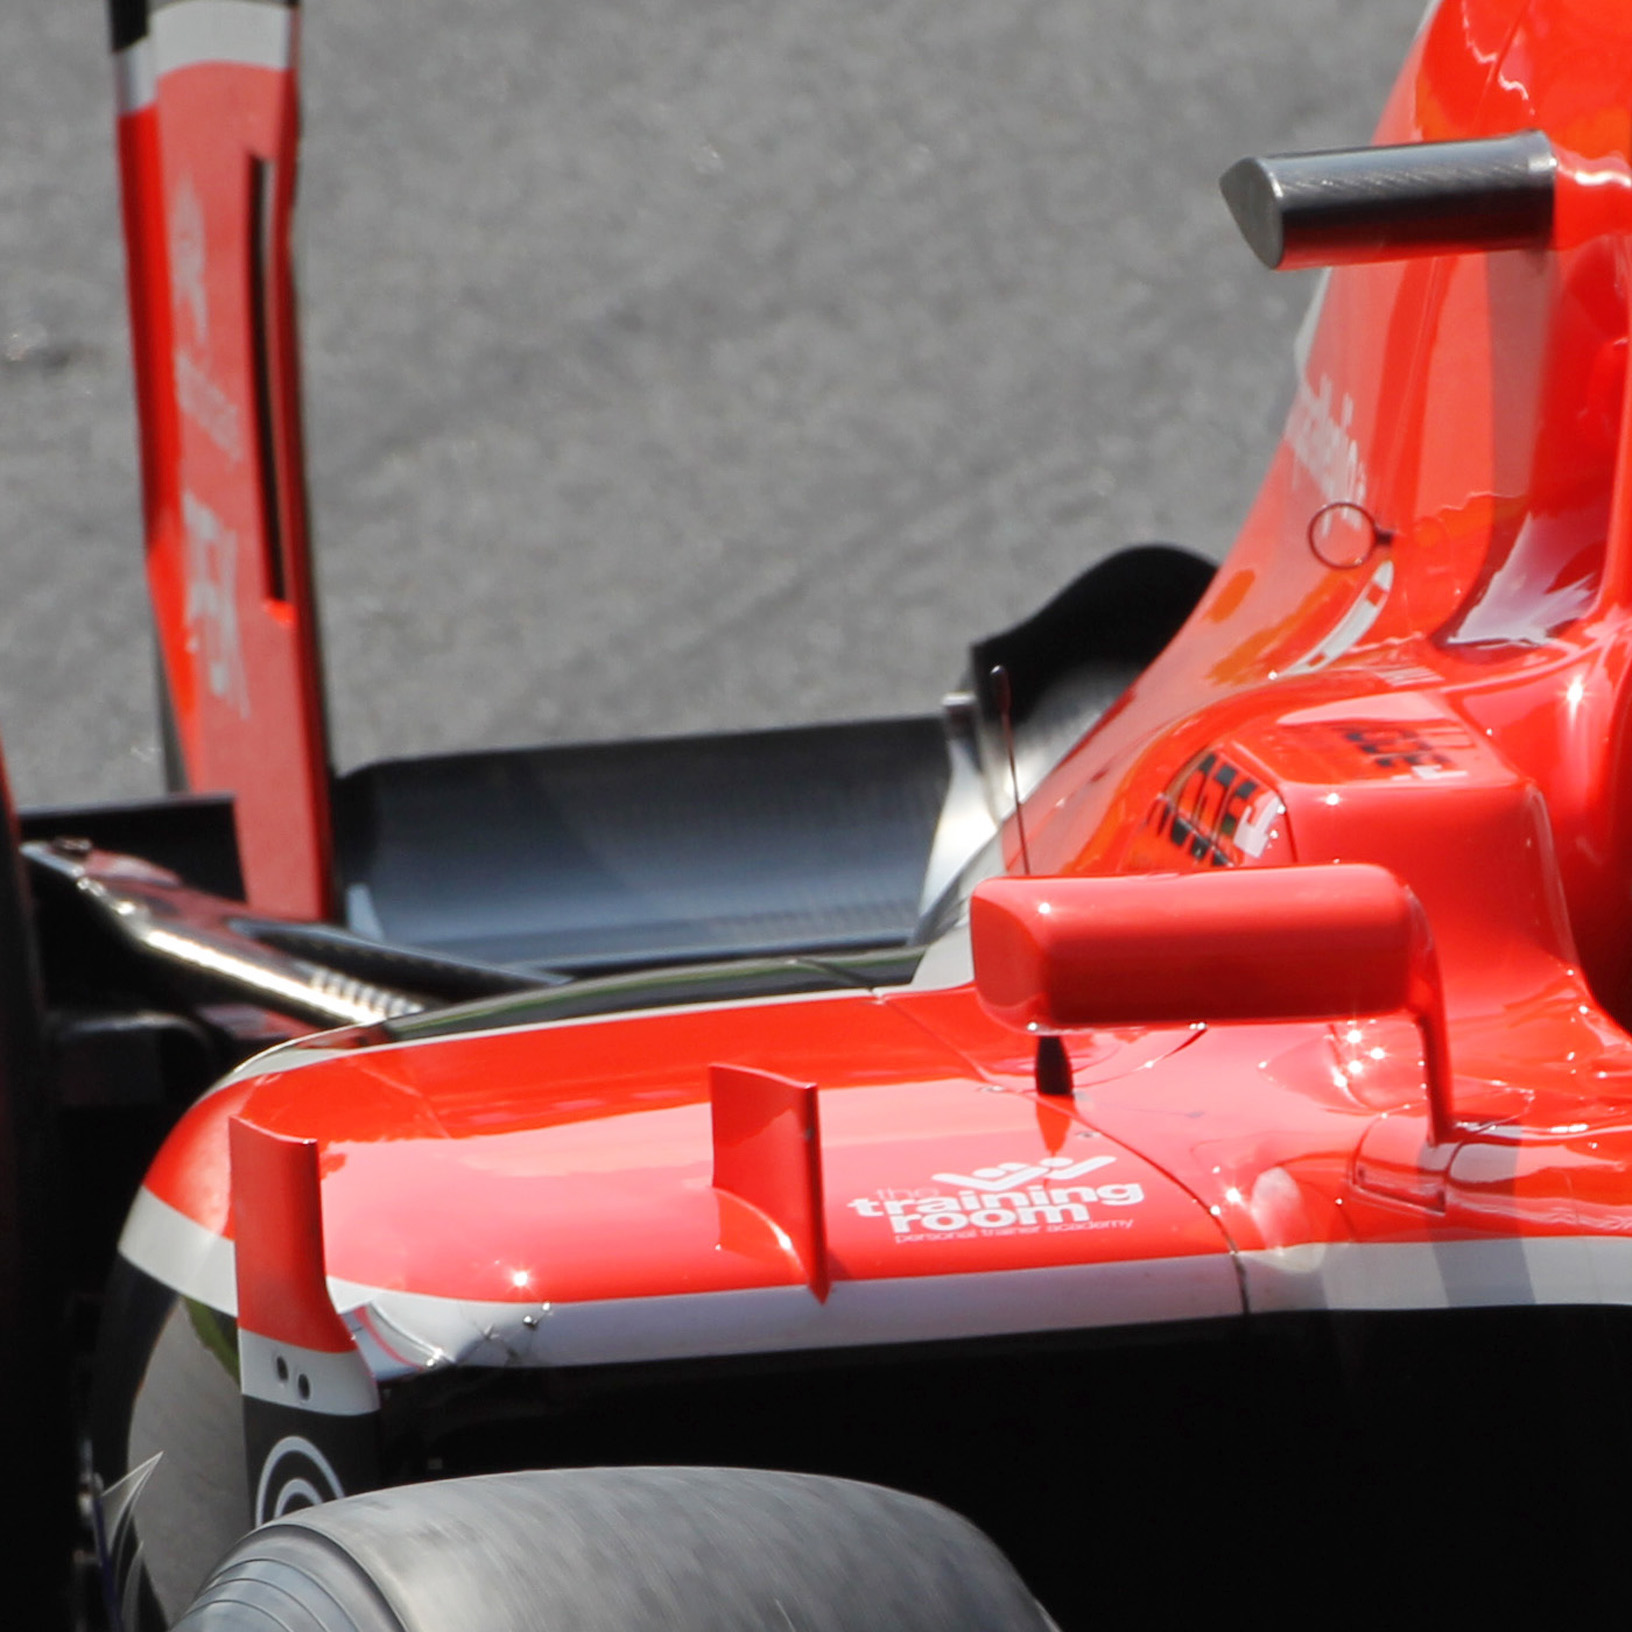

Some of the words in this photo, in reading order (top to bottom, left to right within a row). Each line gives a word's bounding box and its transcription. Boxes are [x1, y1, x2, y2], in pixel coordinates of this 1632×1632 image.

[847, 1182, 1145, 1218] training
[889, 1202, 1090, 1234] room
[895, 1228, 977, 1244] personal
[1046, 1217, 1134, 1233] academy
